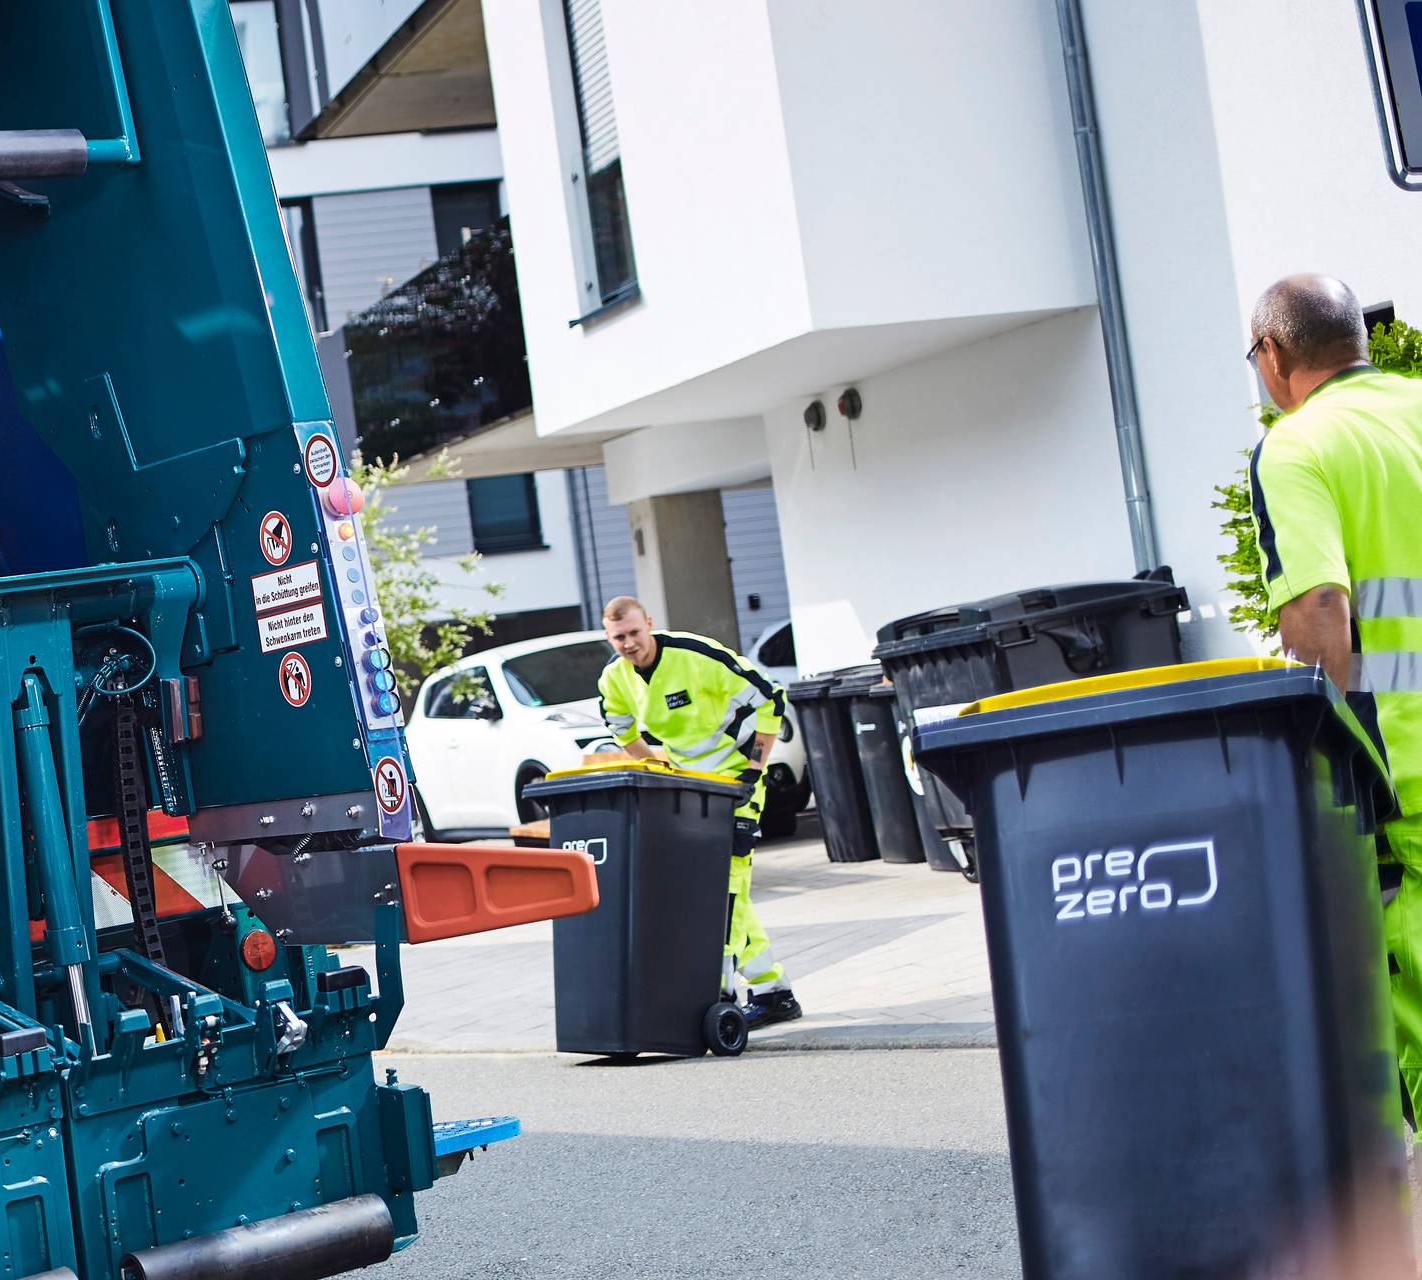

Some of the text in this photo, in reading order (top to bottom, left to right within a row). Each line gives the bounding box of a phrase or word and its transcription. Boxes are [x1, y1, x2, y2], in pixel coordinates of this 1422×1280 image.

[277, 574, 293, 587] Nicht
[255, 581, 319, 606] in die Schüttung greifen
[267, 612, 315, 632] Nicht hinter den
[265, 625, 322, 647] Schwenkarm treten
[1051, 850, 1135, 892] pre
[1054, 883, 1172, 920] zero
